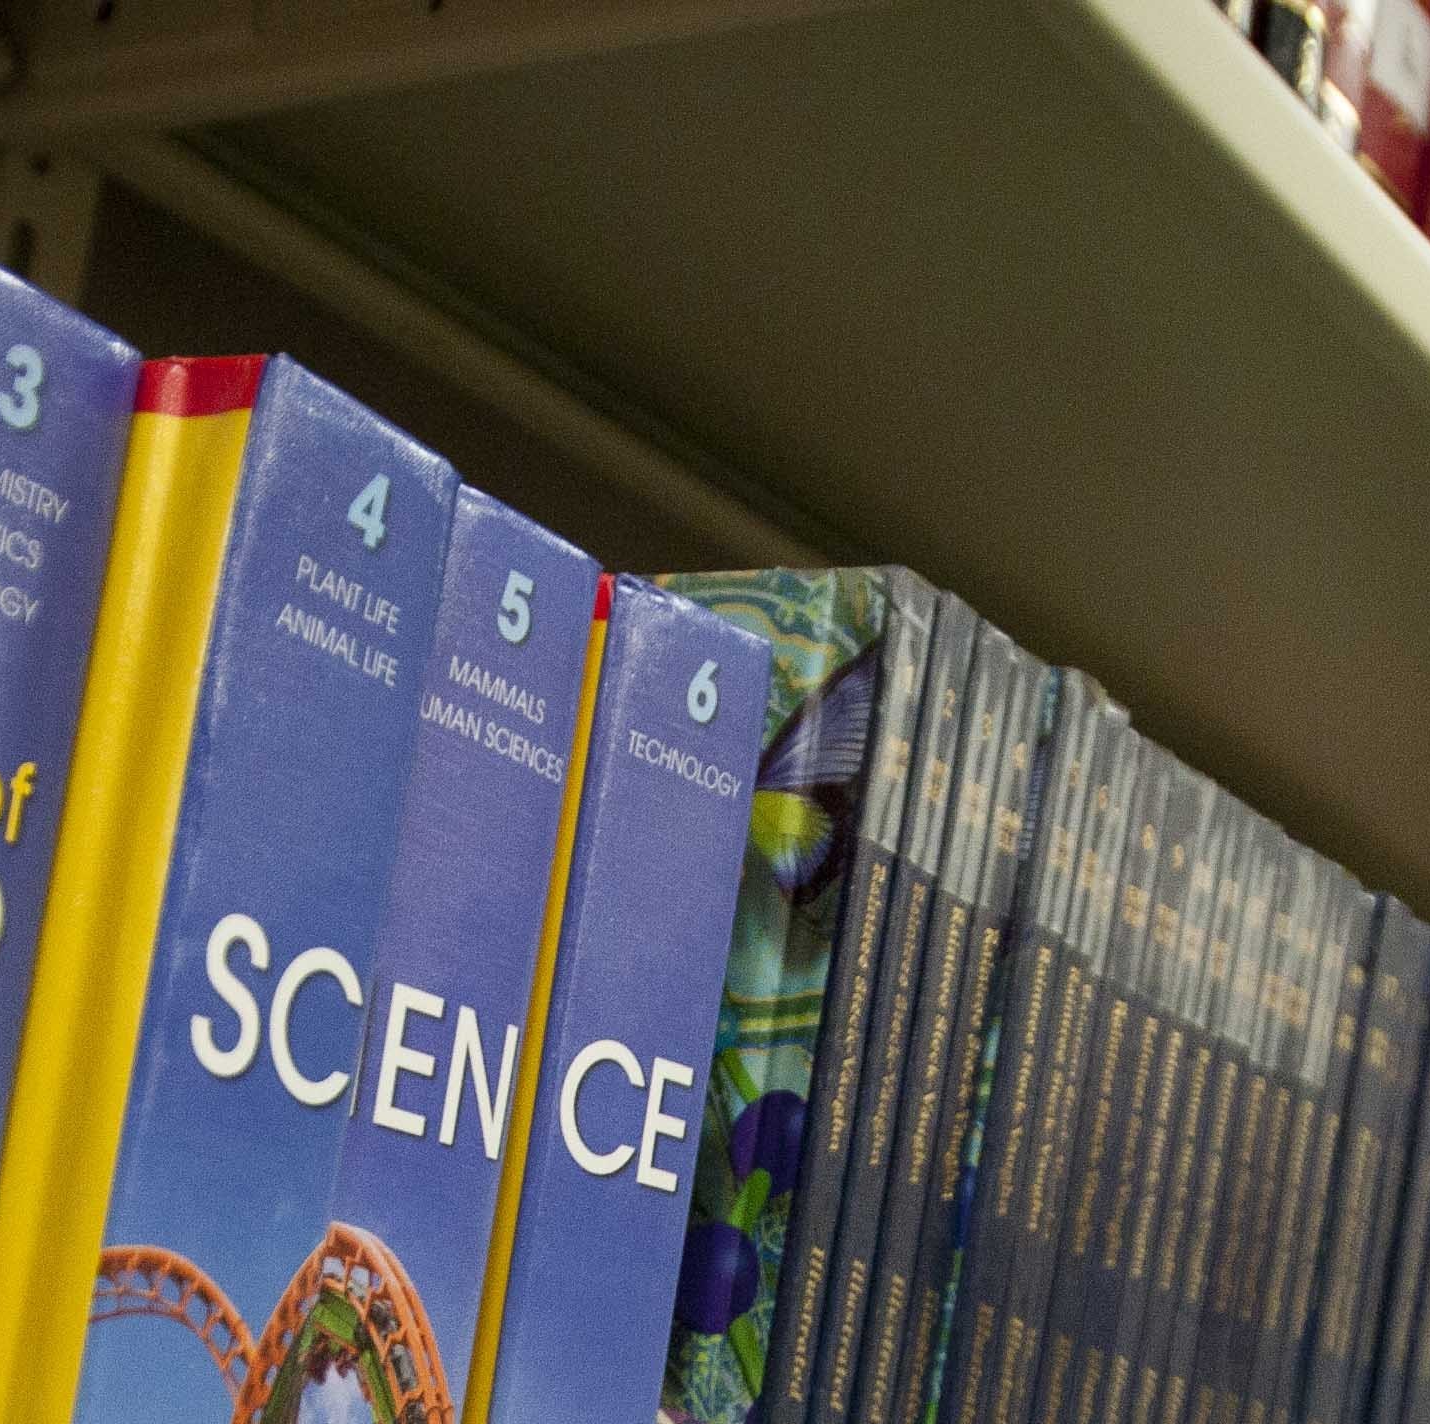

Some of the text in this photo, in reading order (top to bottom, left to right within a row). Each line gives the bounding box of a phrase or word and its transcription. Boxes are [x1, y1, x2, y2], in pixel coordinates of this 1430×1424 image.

[346, 473, 391, 551] 4
[295, 554, 403, 635] PLANT LIFE
[496, 570, 535, 646] 5
[276, 603, 400, 688] ANIMAL LIFE
[450, 654, 548, 725] MAMMALS
[686, 659, 719, 724] 6
[419, 698, 566, 785] UMAN SCIENCES
[628, 730, 743, 800] TECHNOLOGY
